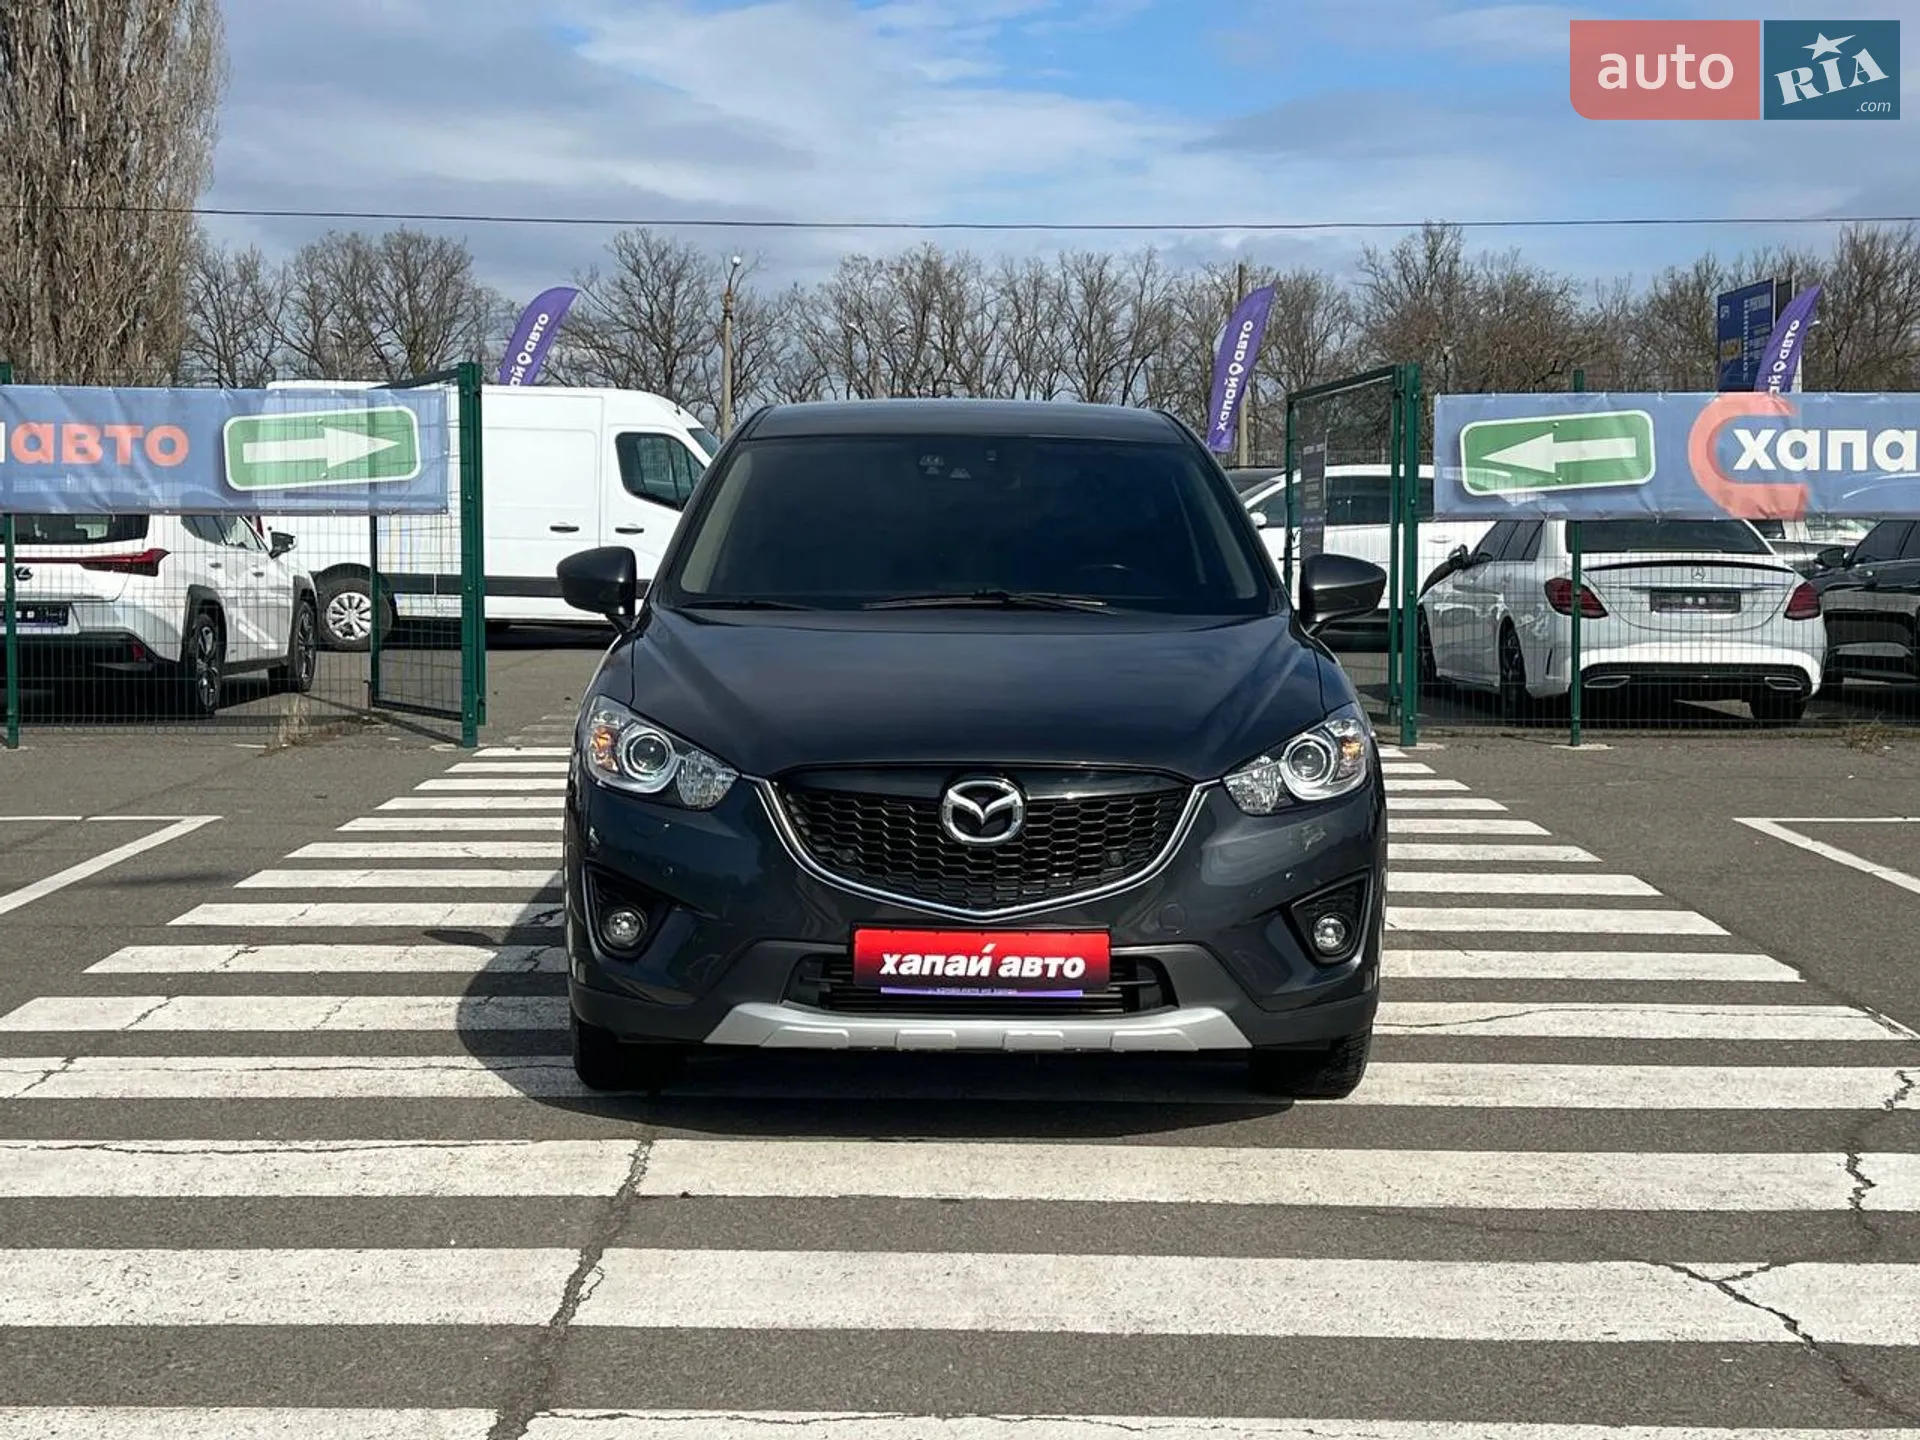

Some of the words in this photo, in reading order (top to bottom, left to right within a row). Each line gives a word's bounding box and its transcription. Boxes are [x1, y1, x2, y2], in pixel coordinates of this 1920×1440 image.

[525, 313, 549, 352] авто
[1779, 320, 1800, 359] авто
[1216, 377, 1240, 431] хапай
[1233, 320, 1253, 361] авто
[0, 422, 189, 467] авто
[1732, 428, 1917, 472] хапа
[998, 955, 1086, 979] авто
